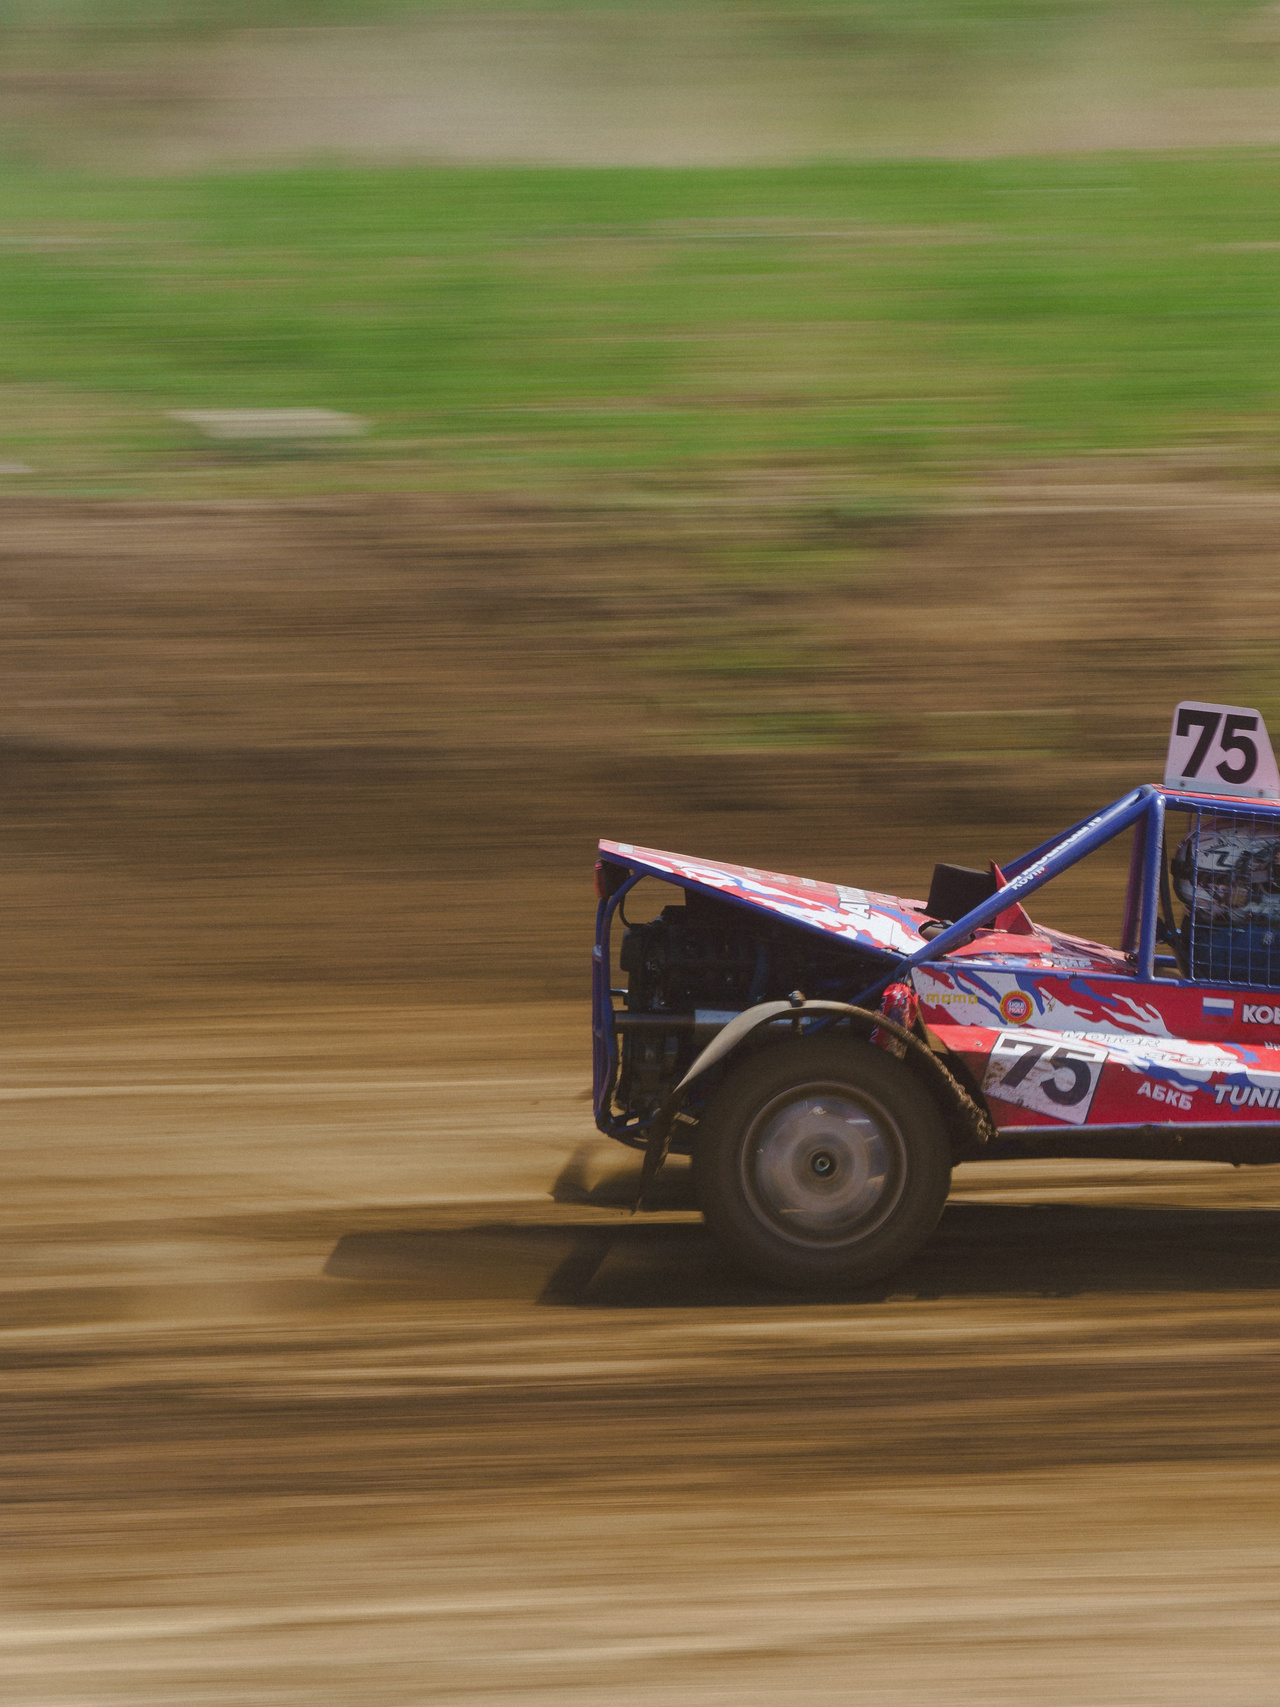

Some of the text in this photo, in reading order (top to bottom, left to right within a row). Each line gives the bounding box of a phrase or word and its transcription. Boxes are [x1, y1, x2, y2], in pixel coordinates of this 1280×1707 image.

[1176, 708, 1259, 785] 75
[1061, 1030, 1161, 1047] MOTOR
[1000, 1038, 1097, 1106] 75
[1137, 1081, 1194, 1111] АБКБ
